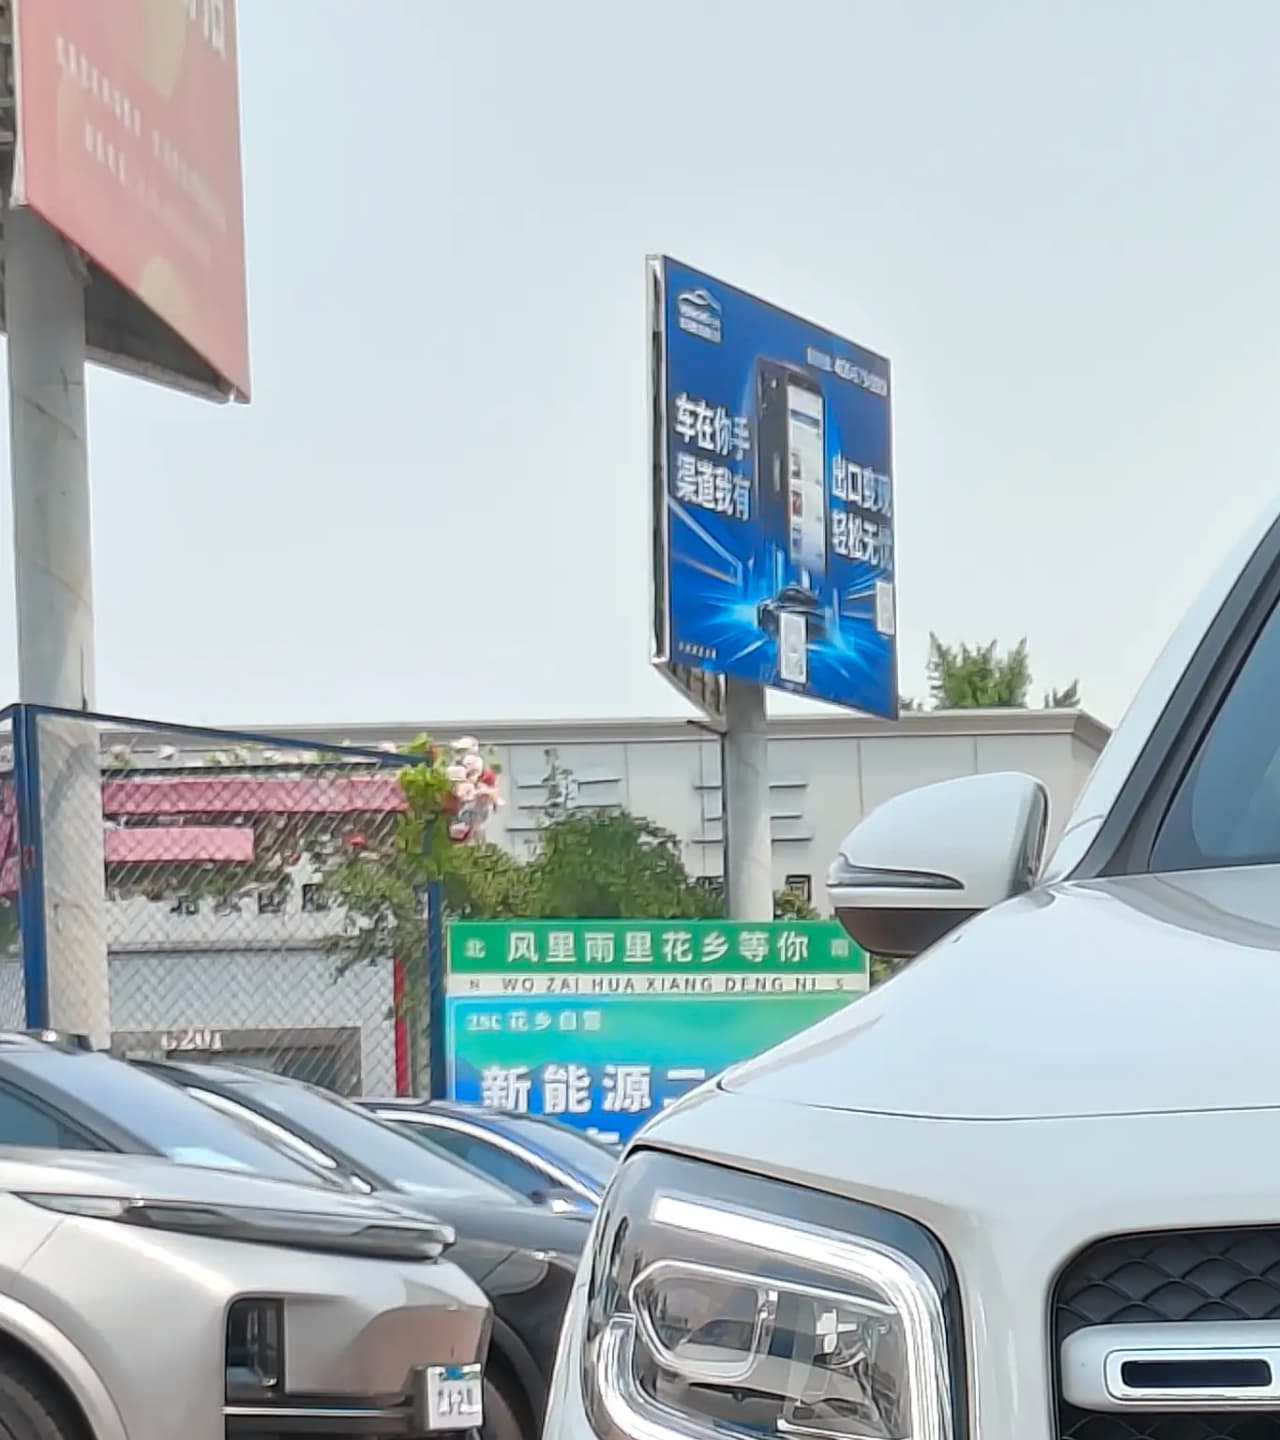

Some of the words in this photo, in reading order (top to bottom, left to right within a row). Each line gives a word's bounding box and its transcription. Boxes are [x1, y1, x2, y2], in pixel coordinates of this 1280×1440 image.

[675, 392, 750, 461] 车在你手
[507, 931, 809, 963] 风里雨里花乡等你
[502, 977, 535, 992] WO
[546, 977, 580, 992] ZAI
[592, 977, 635, 992] HUA
[646, 977, 713, 992] XIANG
[725, 977, 784, 992] DENG
